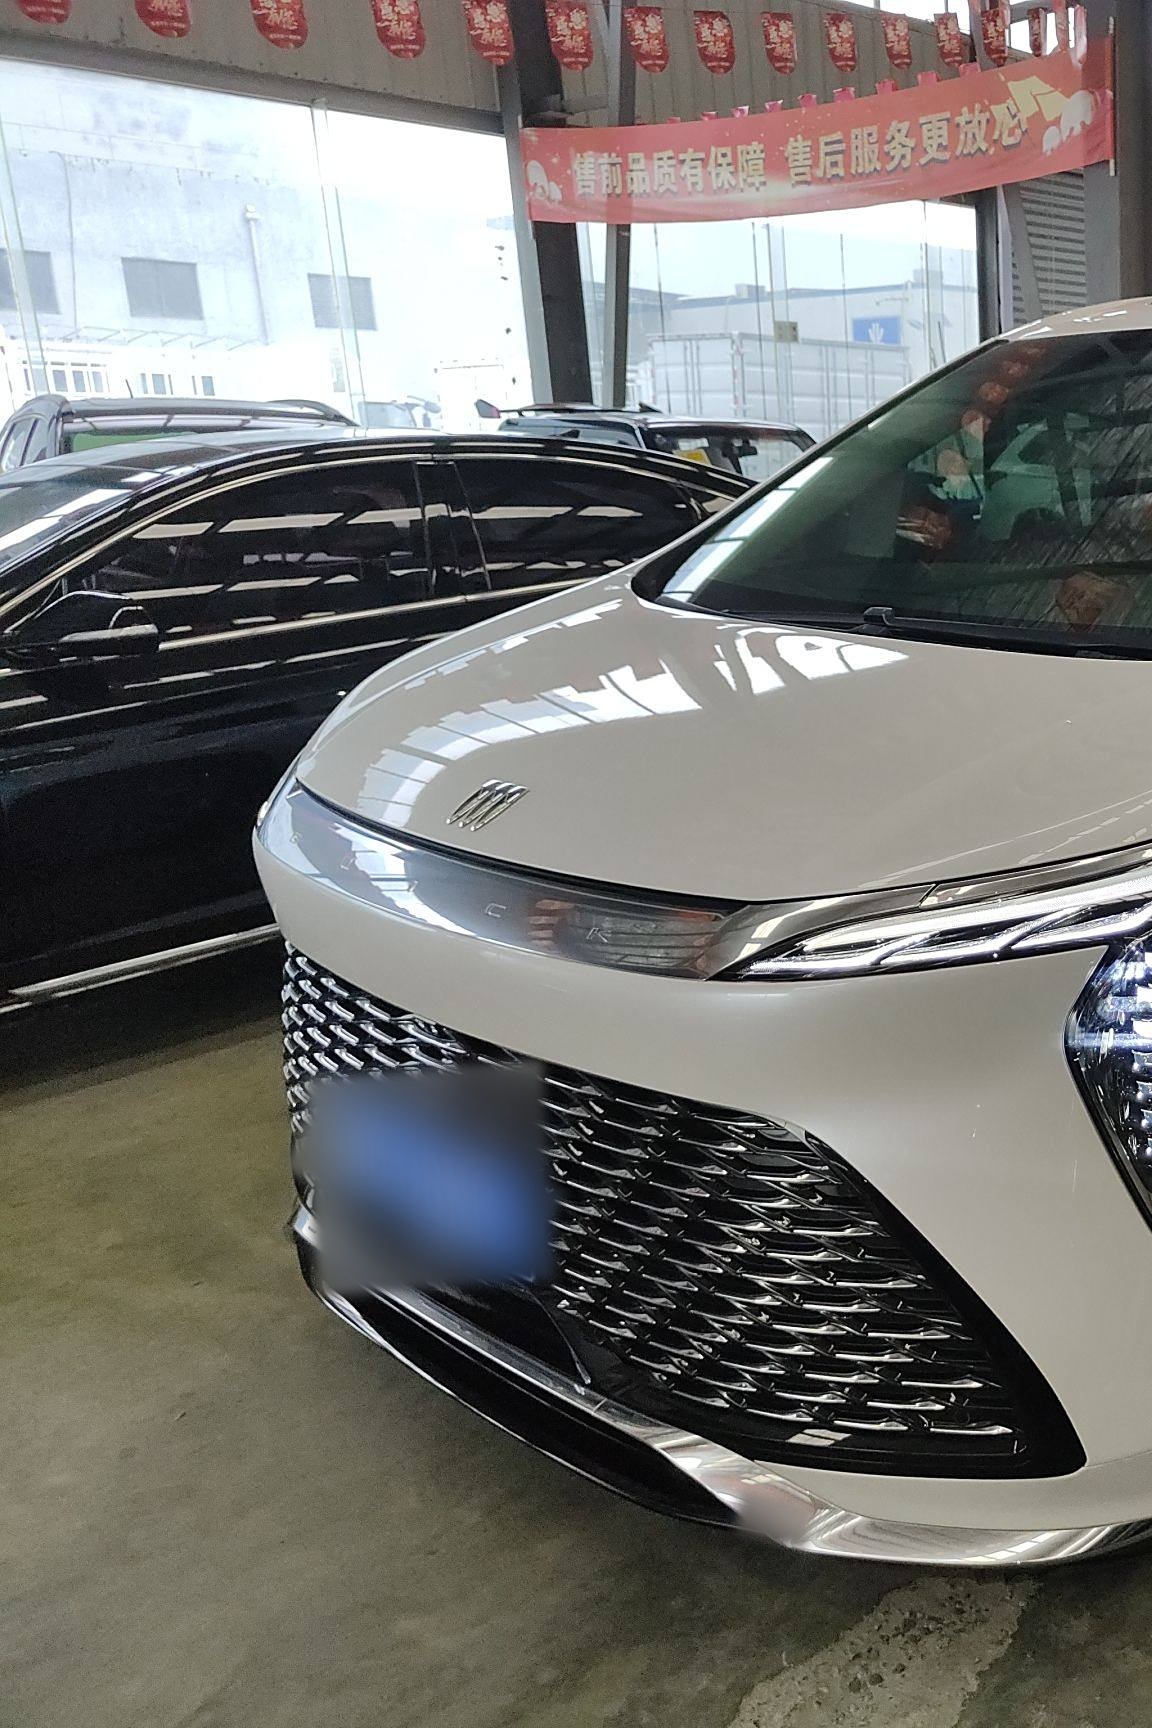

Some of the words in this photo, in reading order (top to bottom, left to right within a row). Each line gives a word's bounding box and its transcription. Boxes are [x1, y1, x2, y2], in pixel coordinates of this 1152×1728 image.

[573, 141, 767, 196] 售前品质有保障
[784, 100, 1028, 188] 售后服务更放心
